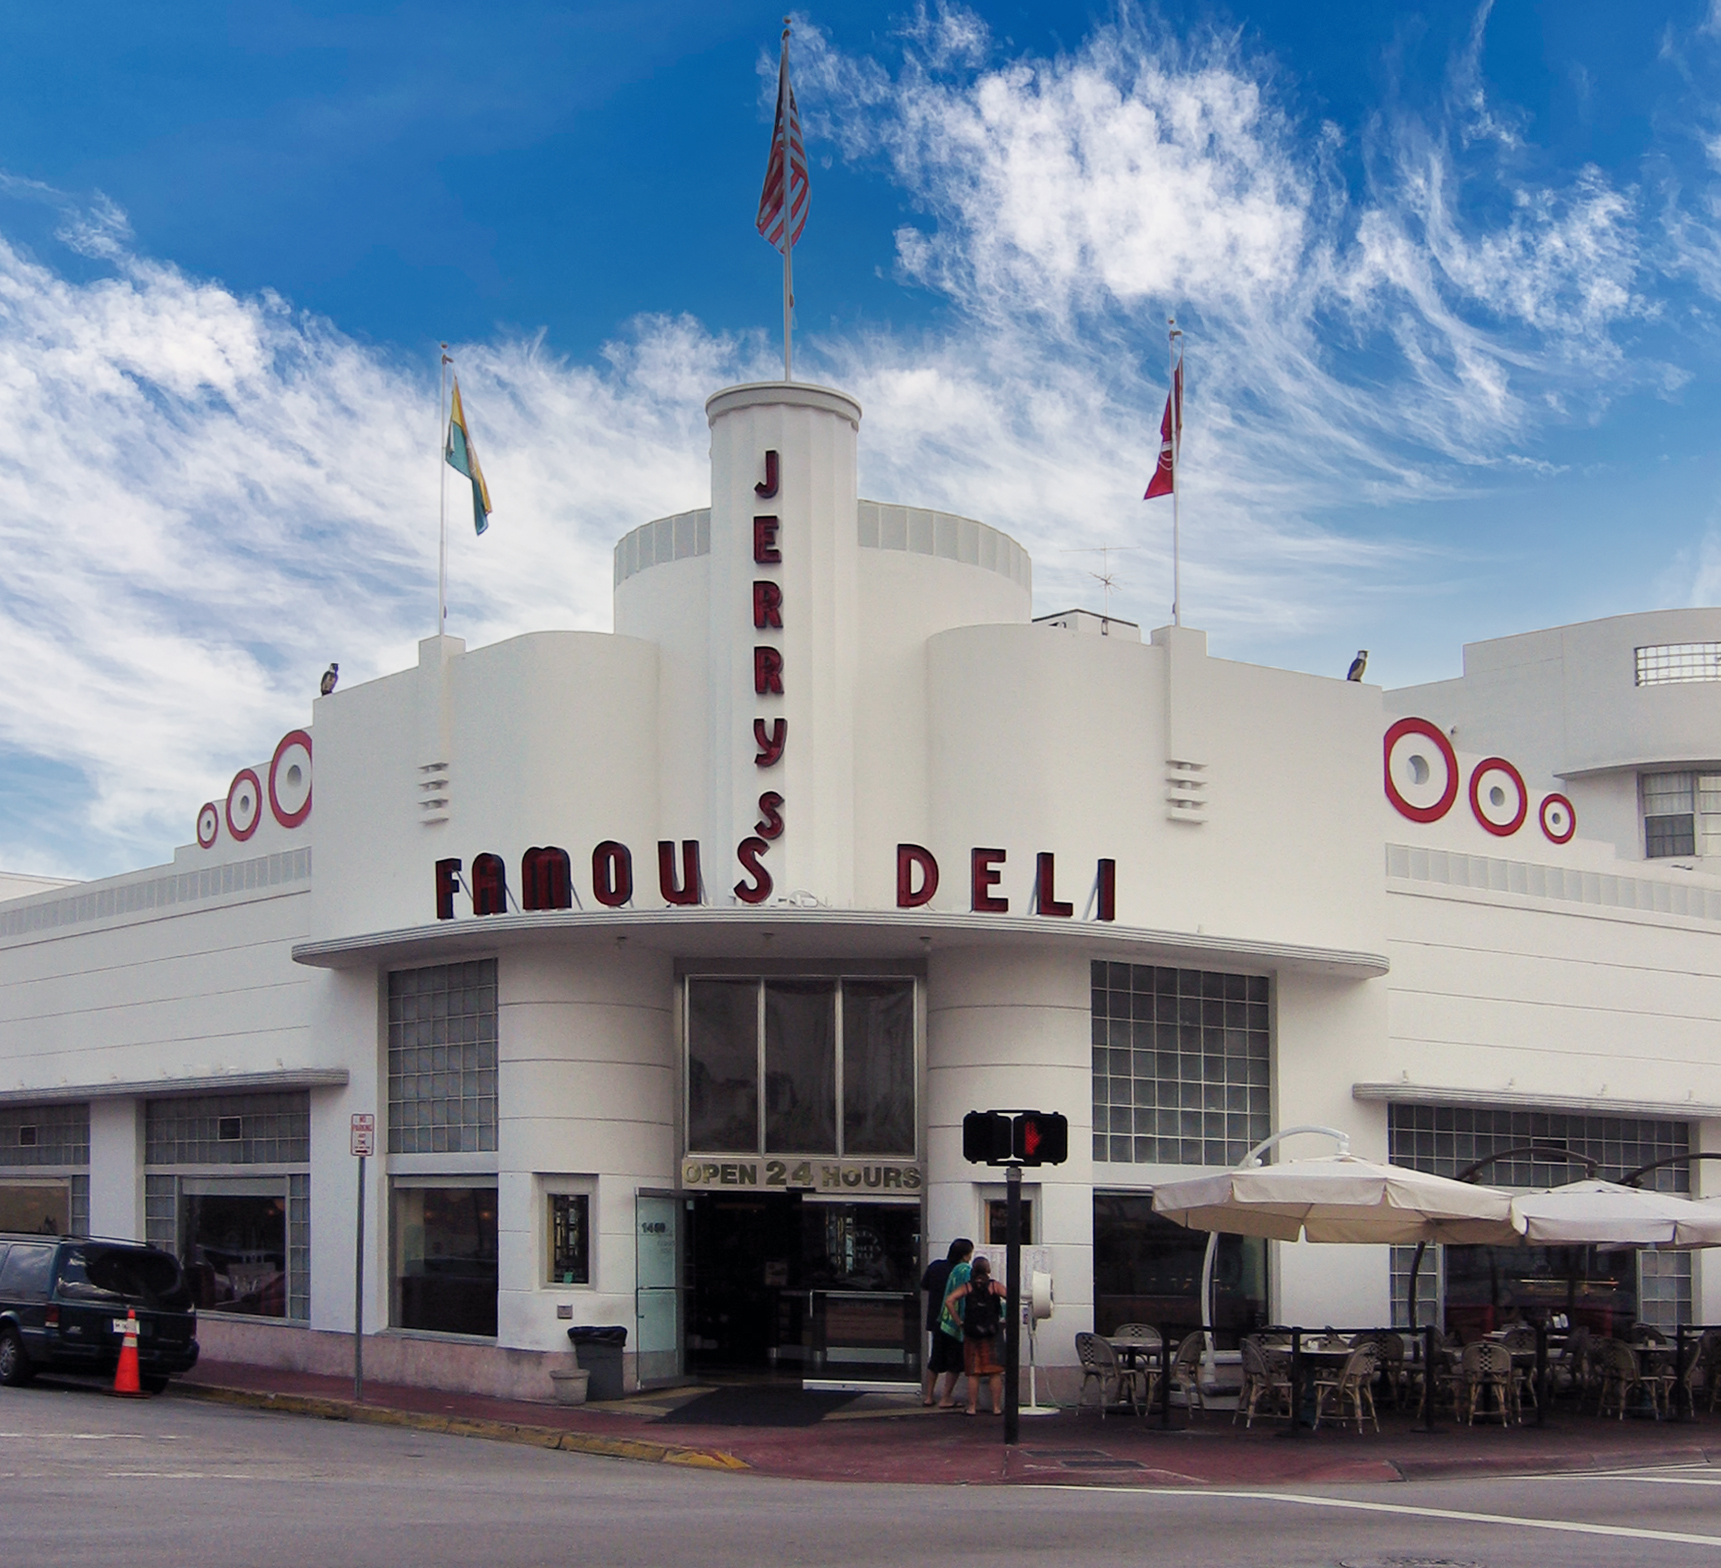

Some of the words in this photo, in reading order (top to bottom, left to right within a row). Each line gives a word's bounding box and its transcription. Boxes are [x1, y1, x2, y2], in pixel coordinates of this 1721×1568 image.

[754, 451, 788, 839] JERRYS
[435, 838, 774, 919] FAMOUS
[897, 845, 1115, 921] DELI
[684, 1162, 757, 1185] OPEN
[766, 1160, 814, 1186] 24
[822, 1165, 921, 1188] HOURS
